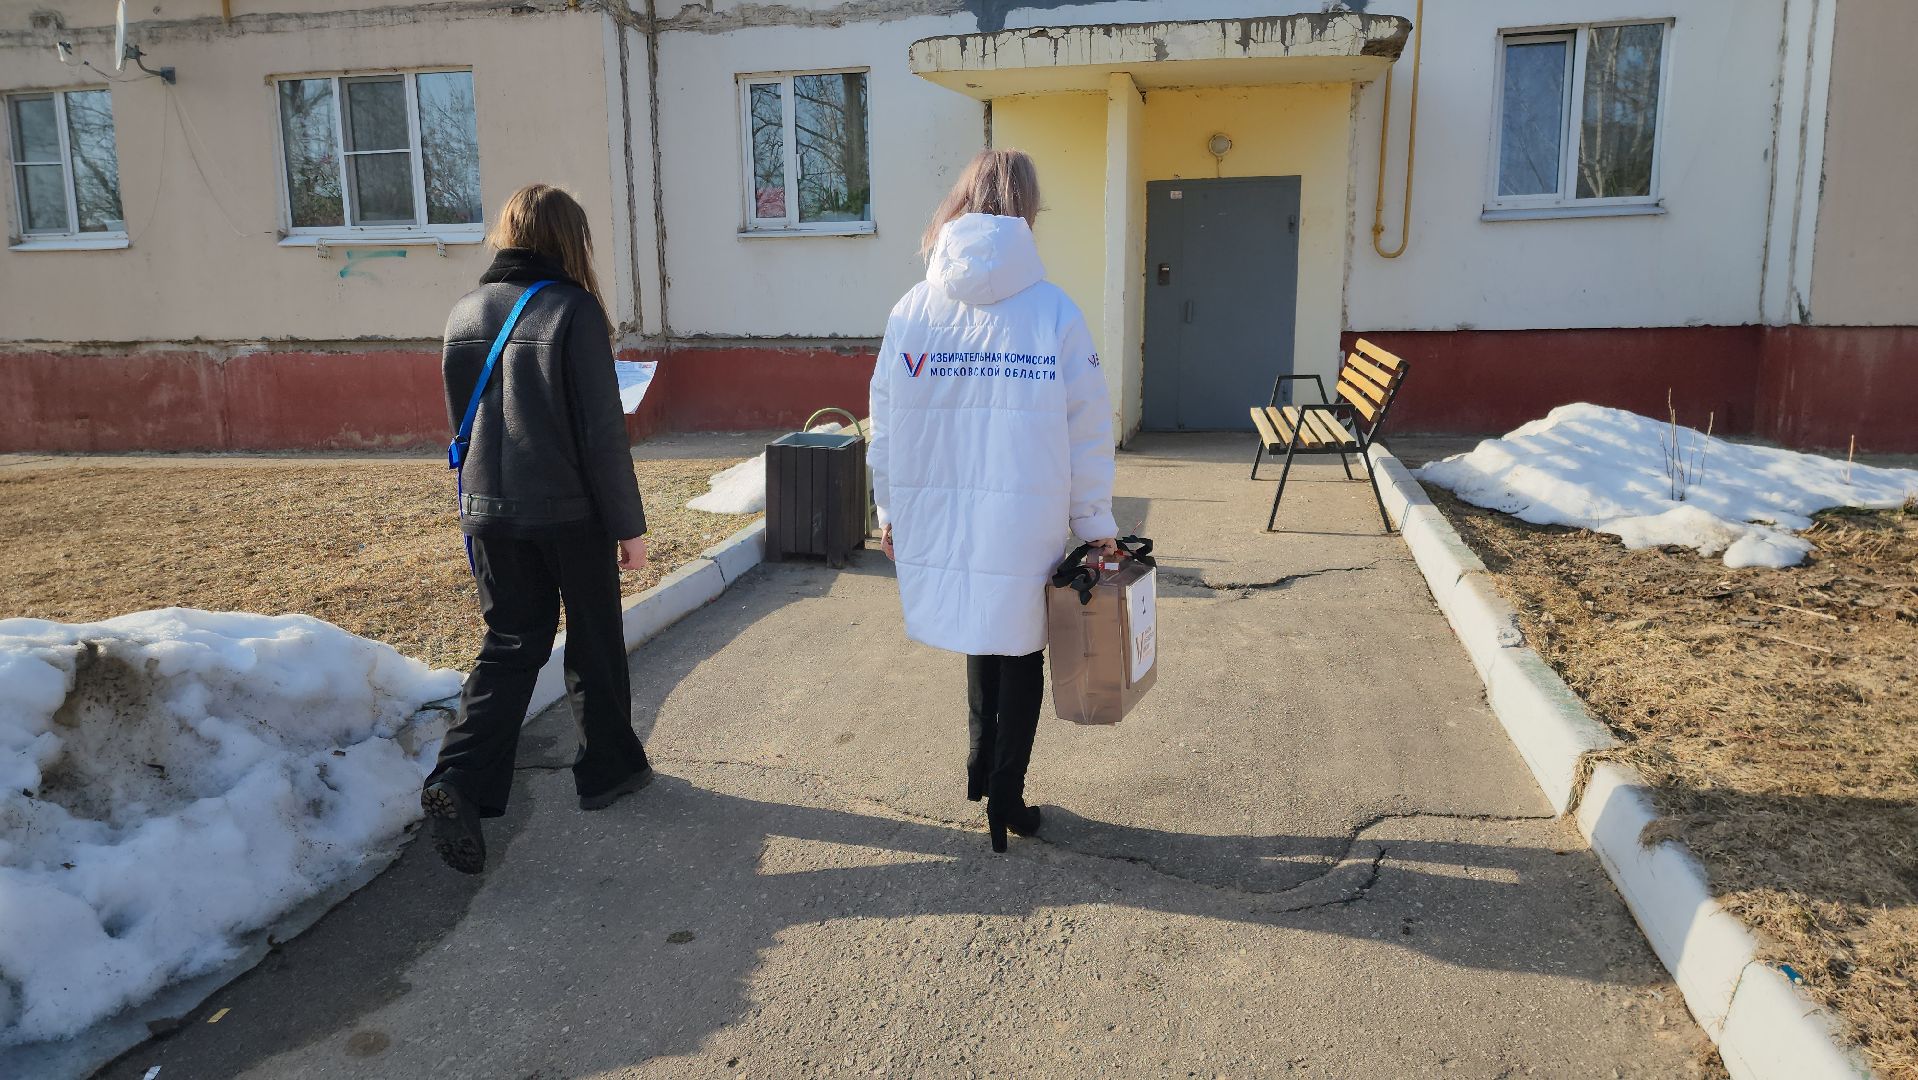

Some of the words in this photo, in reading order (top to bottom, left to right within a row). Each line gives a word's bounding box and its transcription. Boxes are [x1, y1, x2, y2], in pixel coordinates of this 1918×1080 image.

[930, 352, 1001, 363] ИЗБИРАТЕЛЬНАЯ
[1004, 352, 1056, 366] КОМИССИЯ
[930, 364, 1000, 377] МОСКОВСКОЙ
[1004, 367, 1056, 381] ОБЛАСТИ
